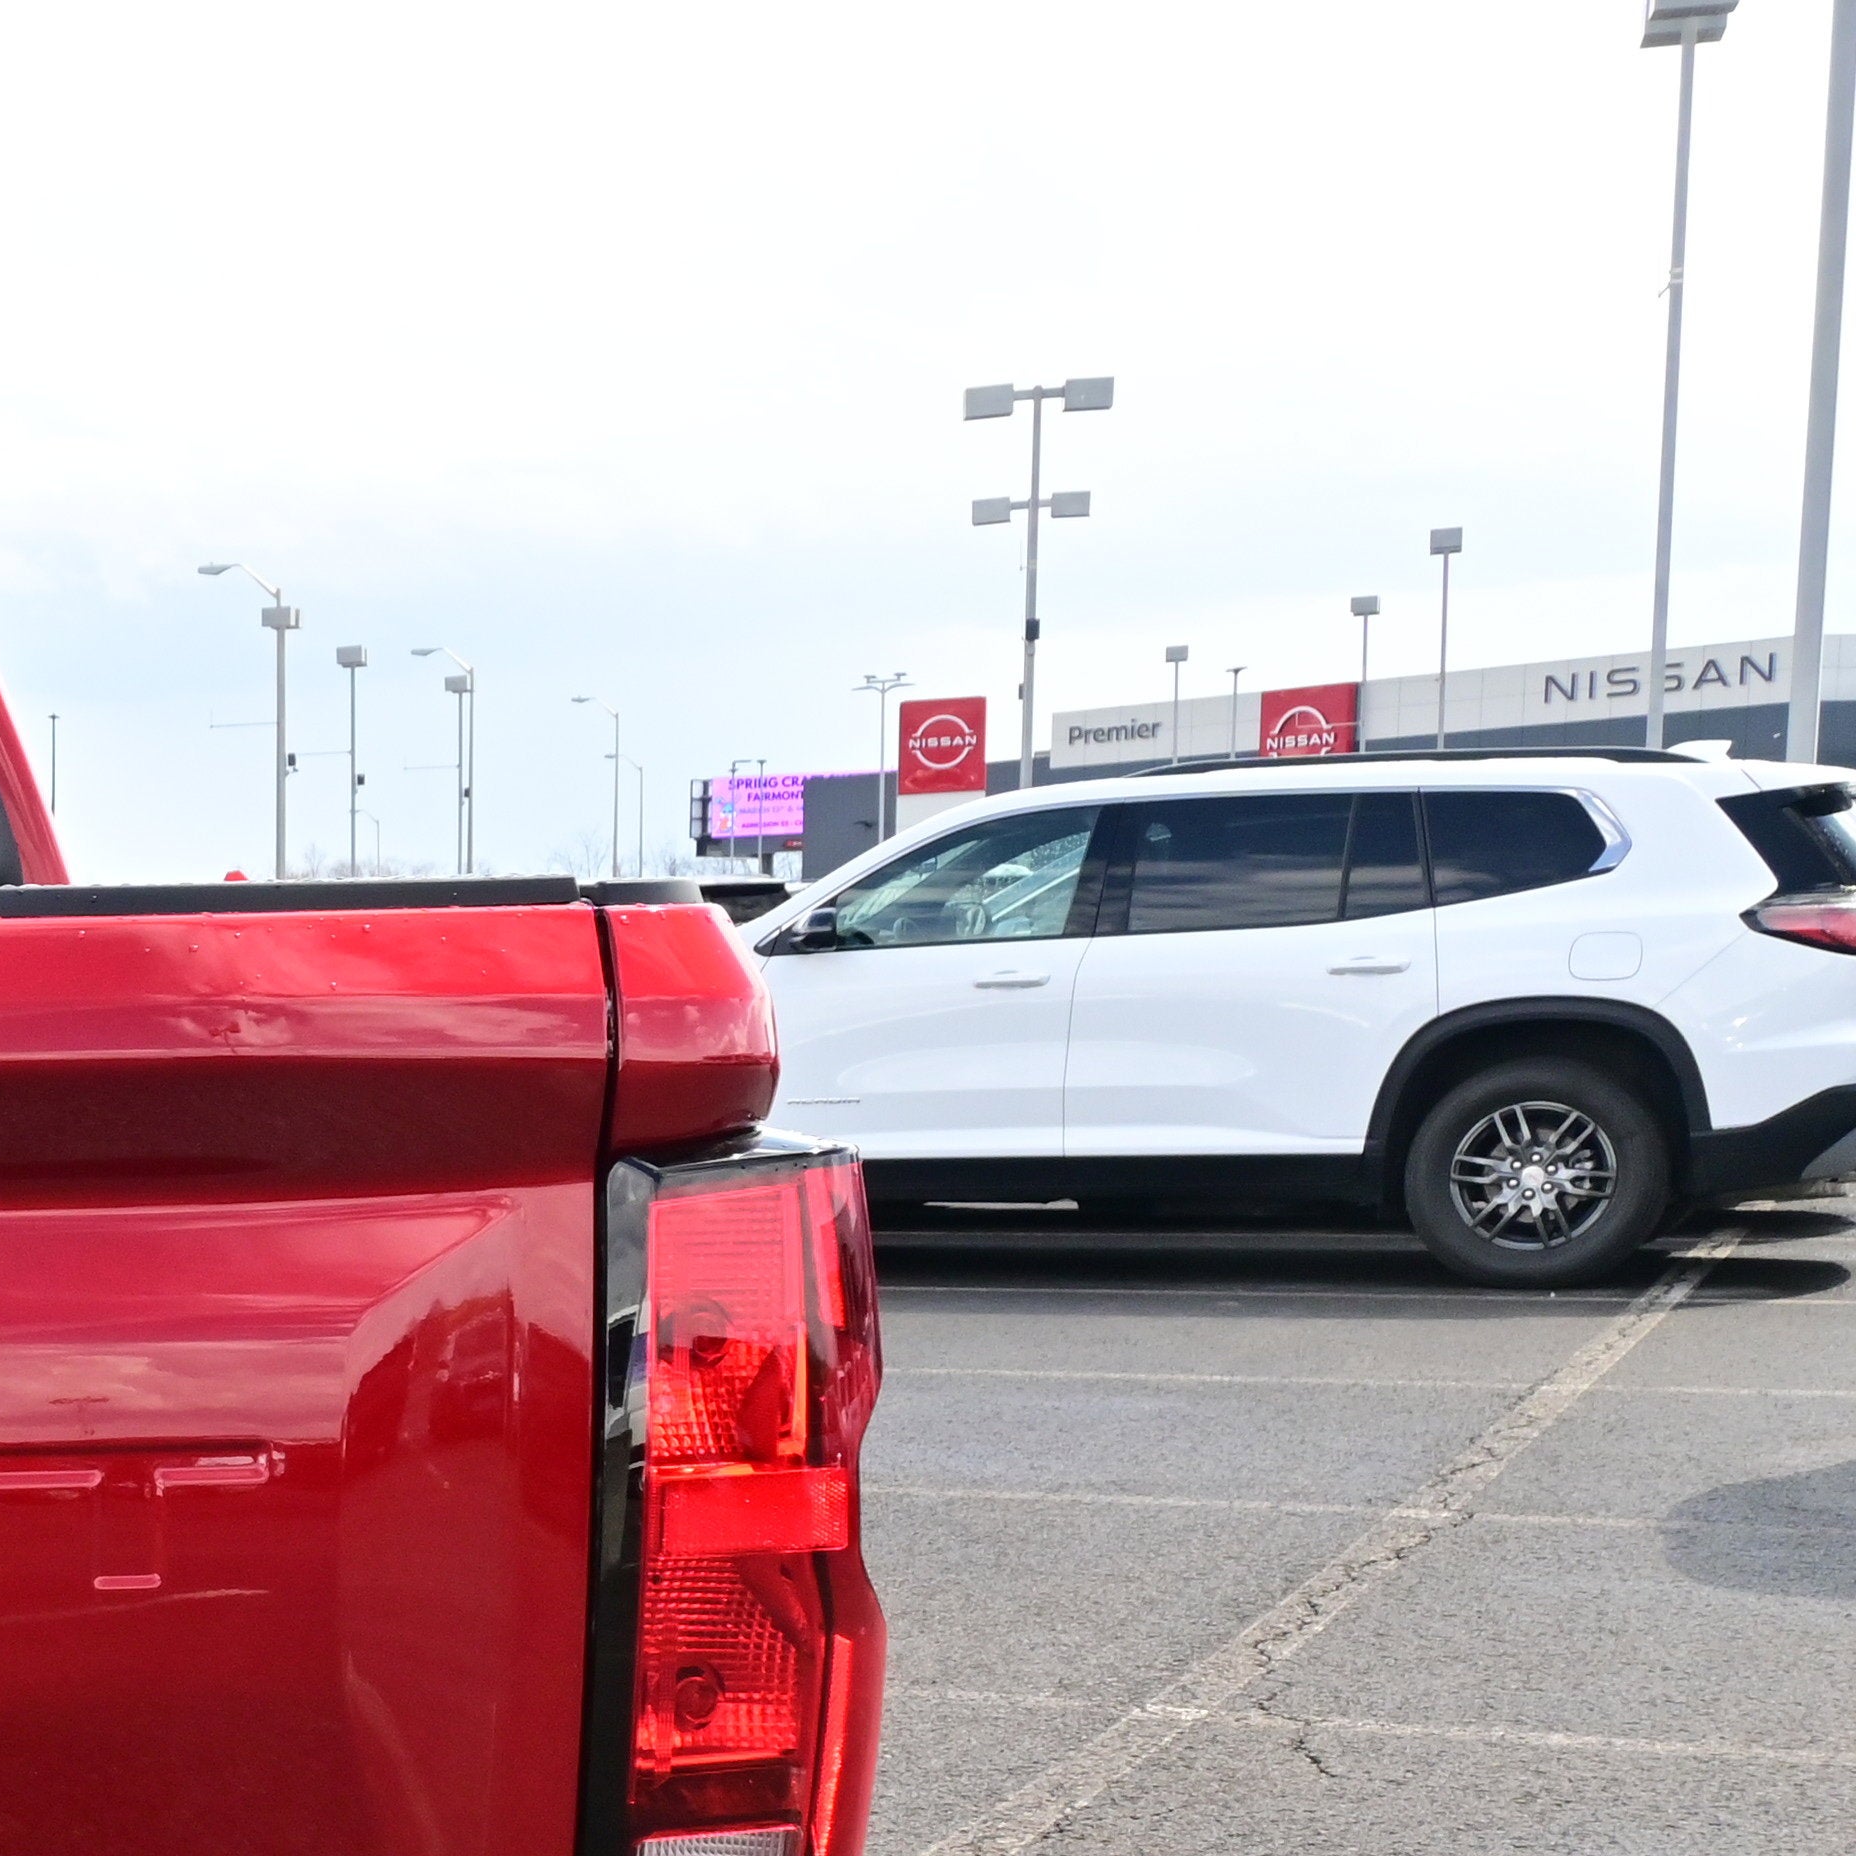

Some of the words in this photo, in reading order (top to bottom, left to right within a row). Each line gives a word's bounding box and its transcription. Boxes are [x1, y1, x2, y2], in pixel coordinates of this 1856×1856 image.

[1543, 651, 1777, 704] NISSAN
[1068, 718, 1162, 745] Premier
[908, 734, 977, 749] NISSAN
[1266, 732, 1335, 750] NISSAN
[728, 776, 779, 791] SPRING
